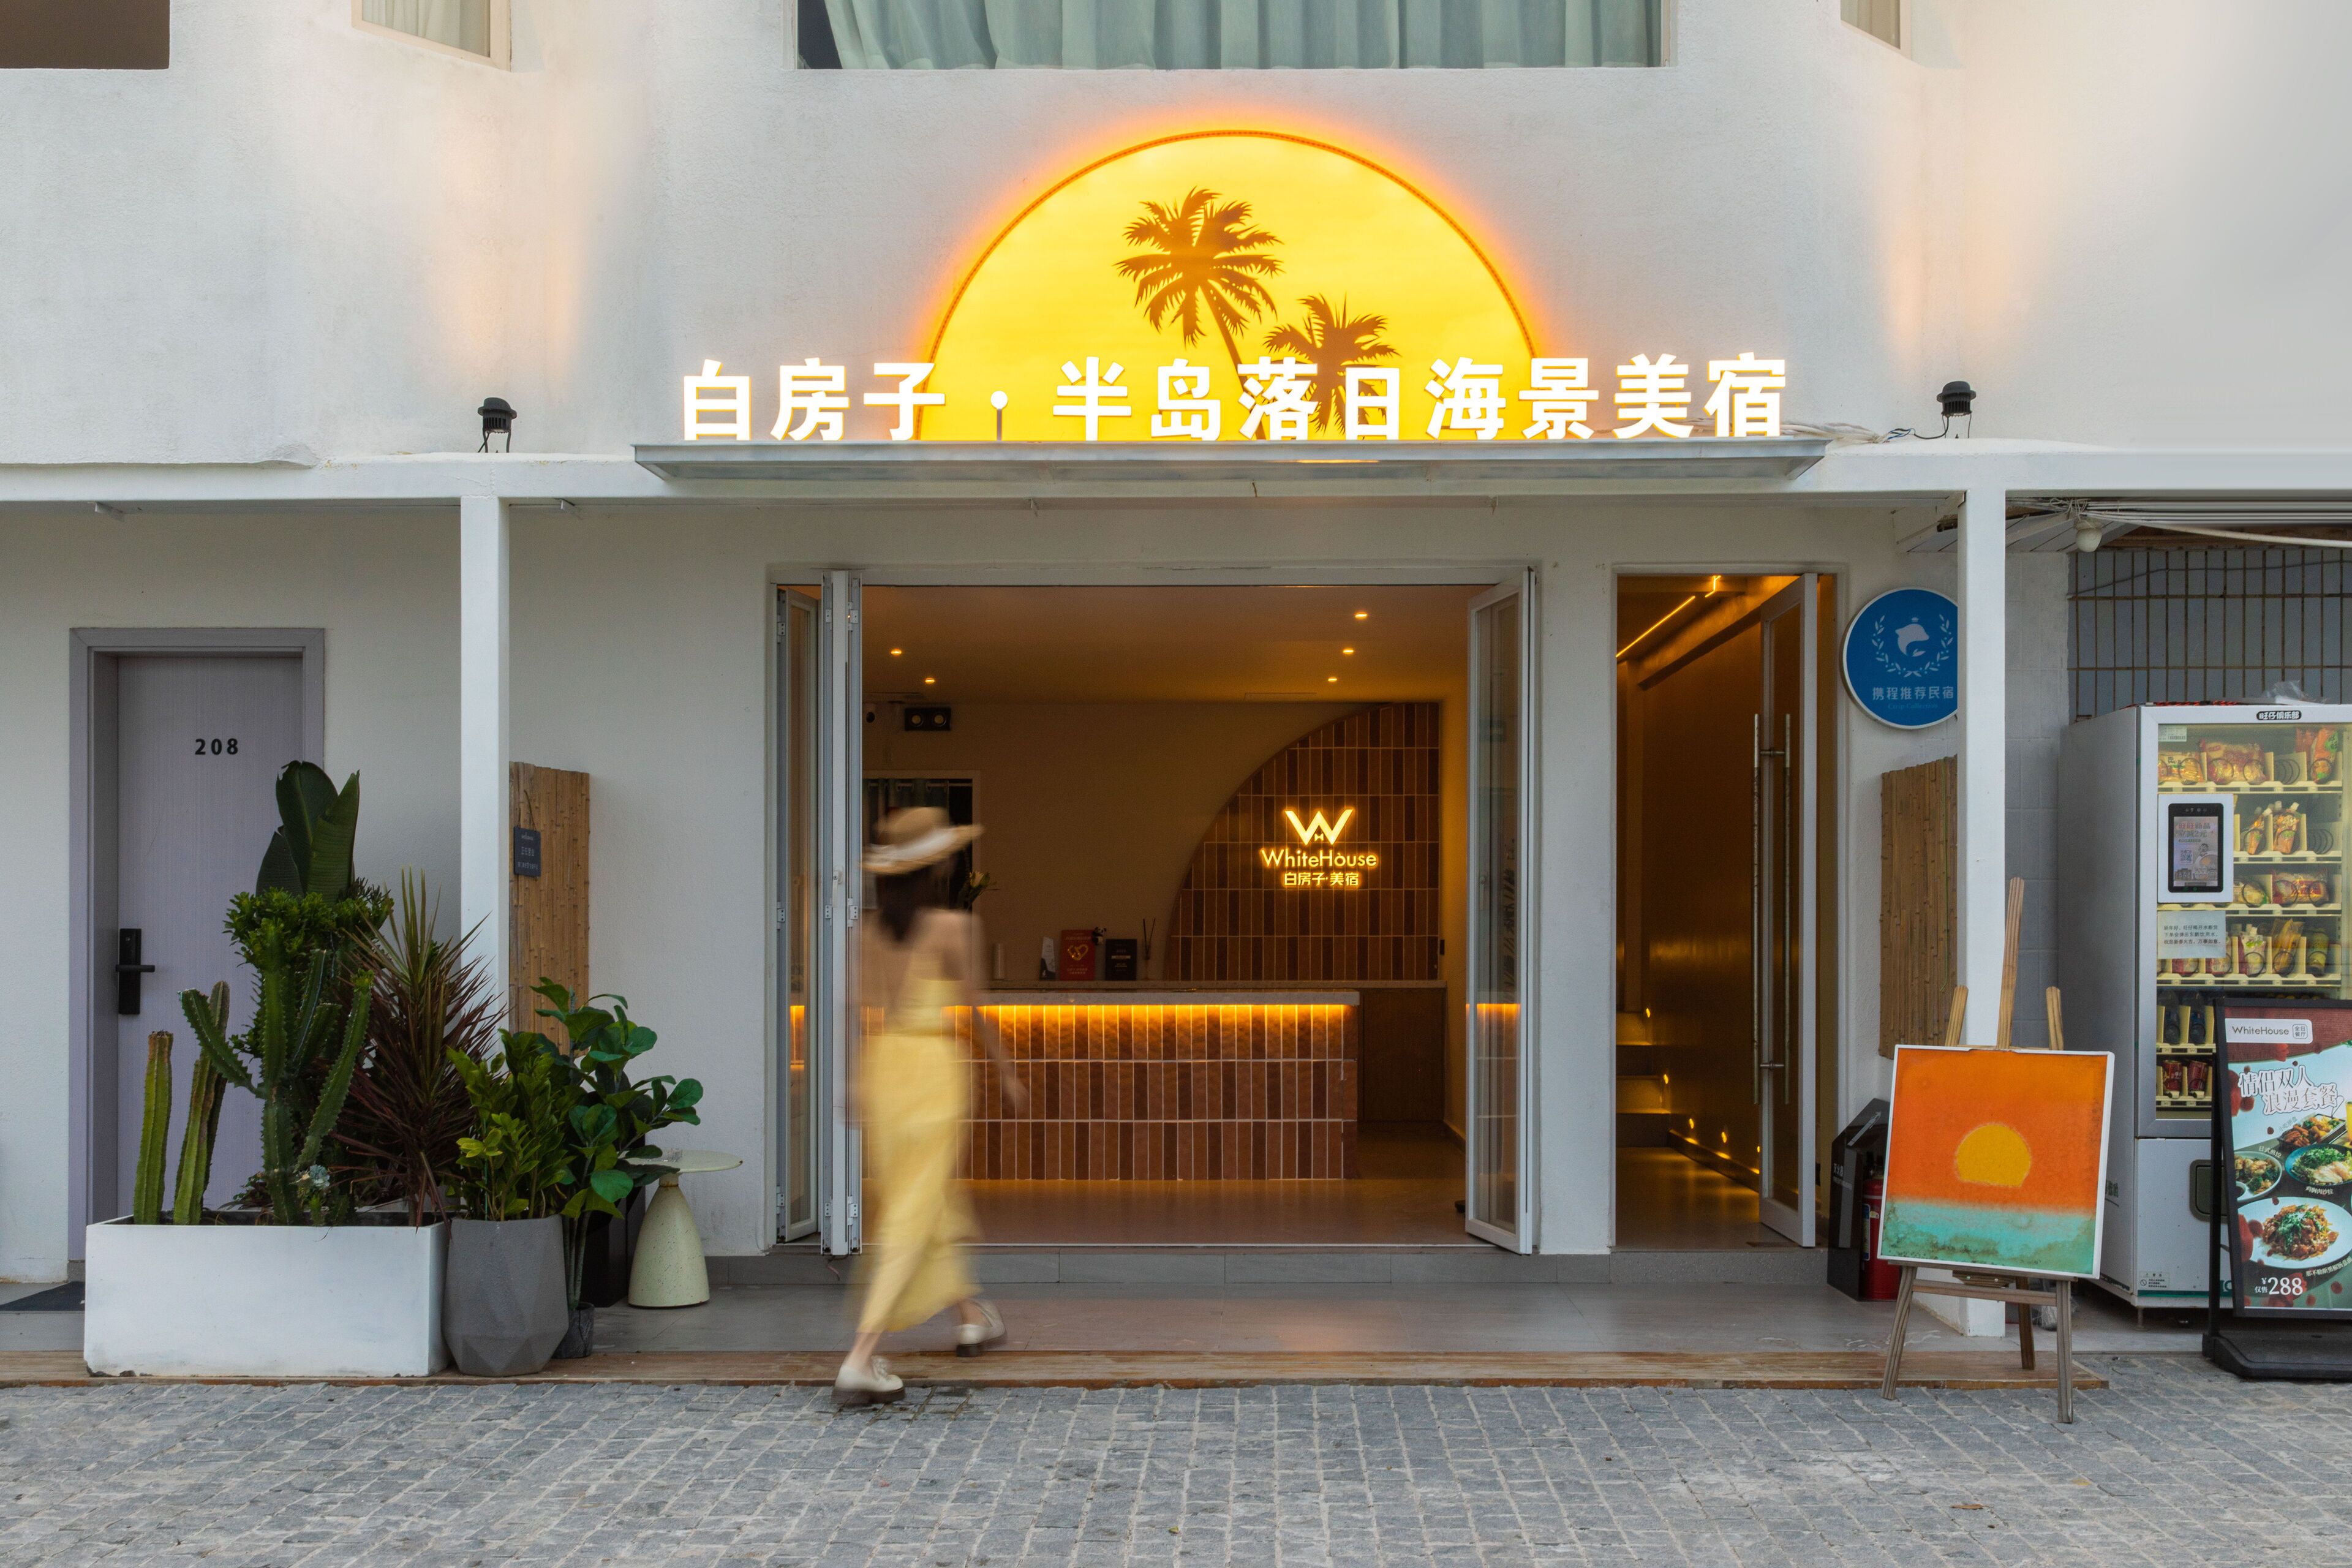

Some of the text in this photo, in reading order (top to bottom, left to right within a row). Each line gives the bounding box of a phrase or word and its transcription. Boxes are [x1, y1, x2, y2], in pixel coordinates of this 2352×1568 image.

[1872, 686, 1954, 701] 携程推荐民宿
[2259, 711, 2299, 720] 旺仔俱乐部
[195, 738, 238, 755] 208
[1261, 847, 1378, 868] WhiteHouse
[2232, 1026, 2290, 1035] WhiteHouse
[2239, 1066, 2313, 1098] 情侣双人
[2263, 1084, 2337, 1114] 浪漫套餐
[2267, 1277, 2303, 1295] 288
